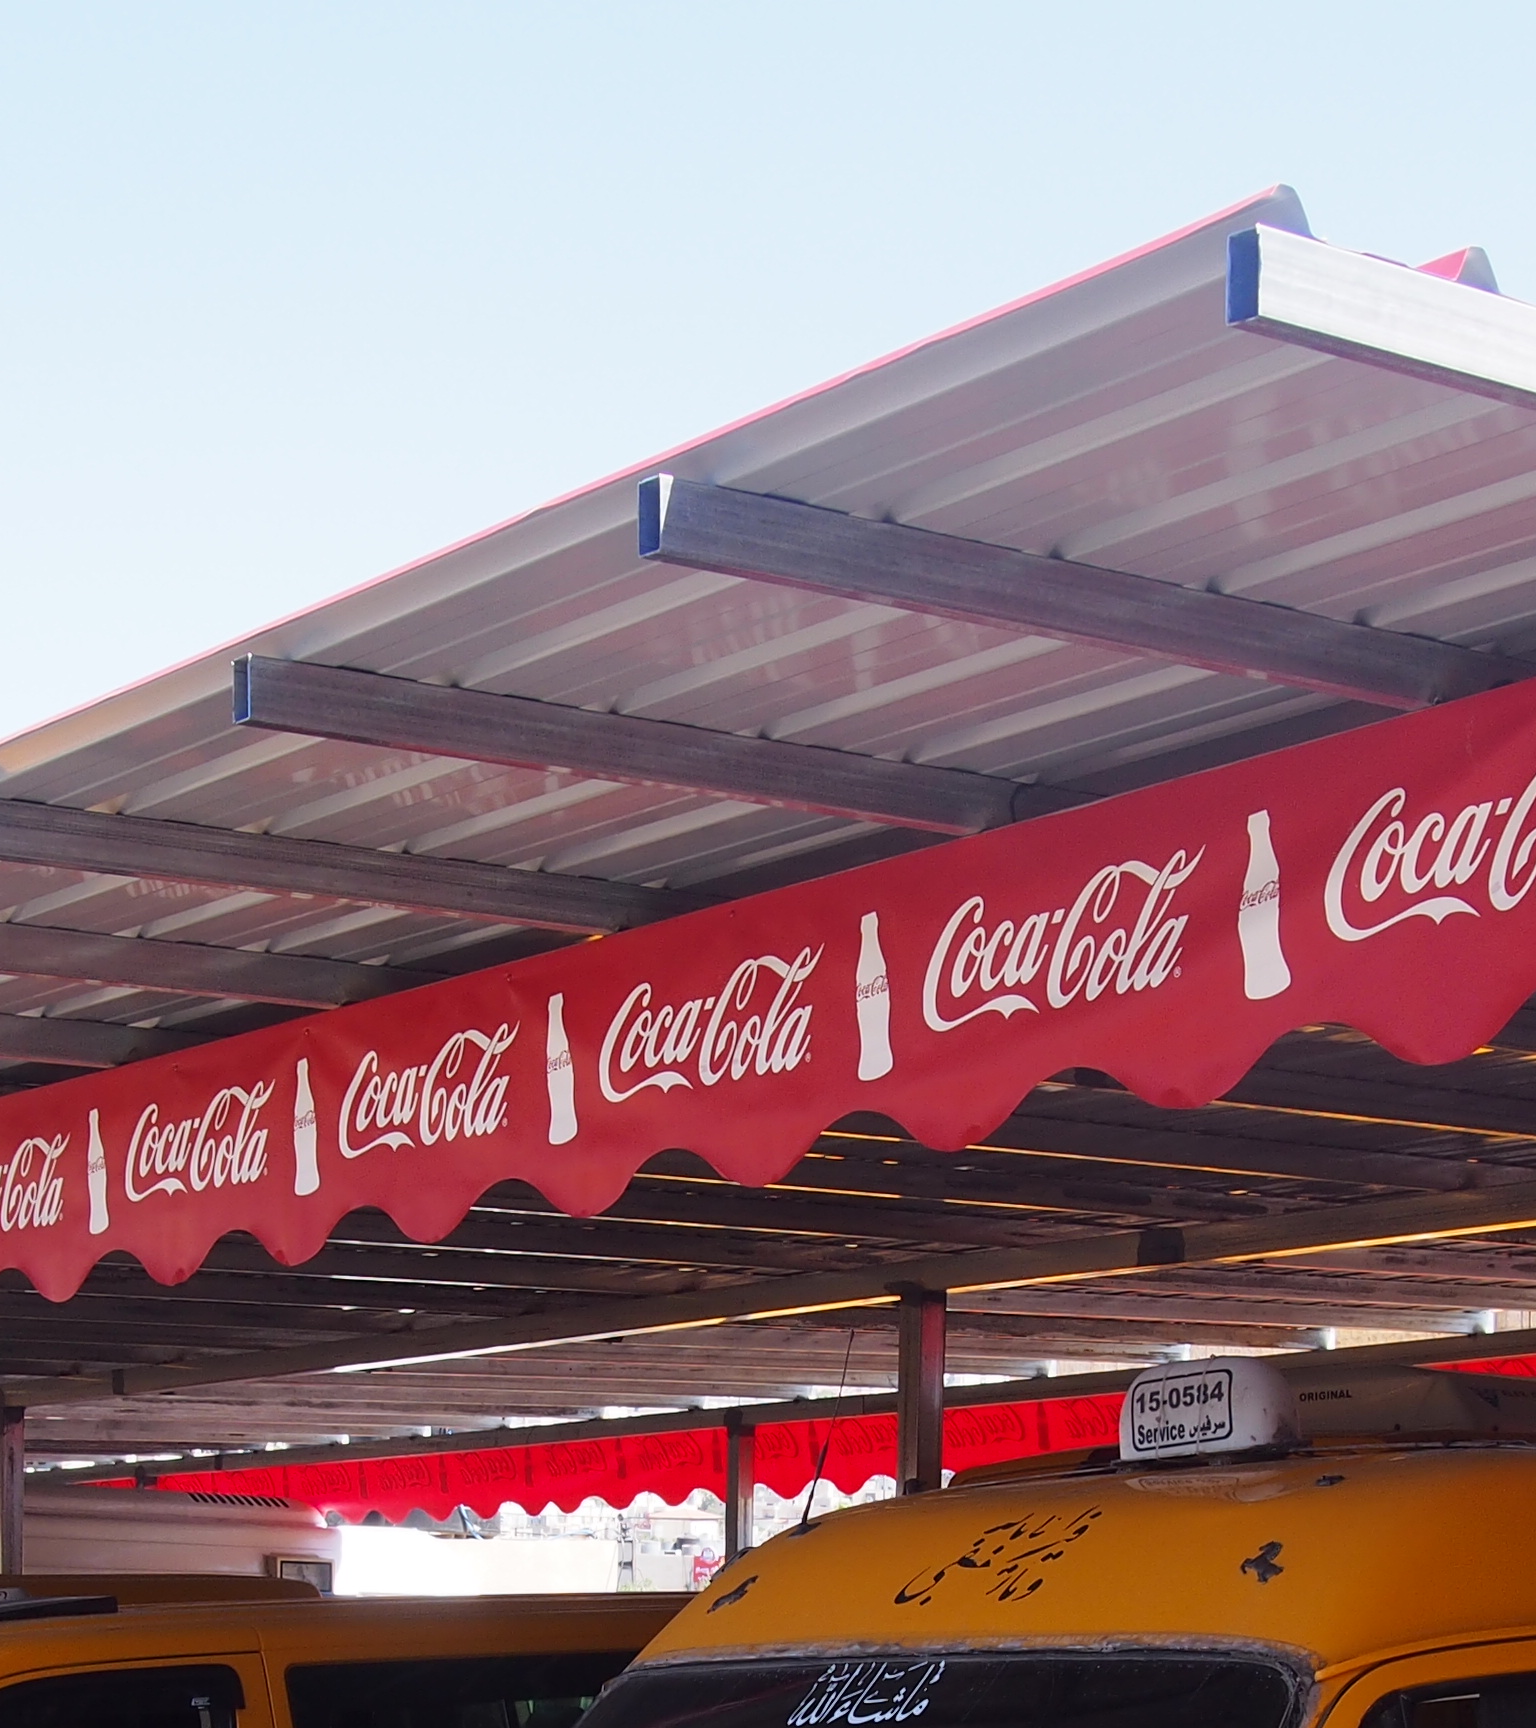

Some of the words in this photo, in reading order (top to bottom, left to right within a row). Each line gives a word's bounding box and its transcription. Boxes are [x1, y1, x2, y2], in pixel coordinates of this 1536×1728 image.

[922, 843, 1206, 1033] Coca-Cola
[598, 943, 824, 1103] Coca-Cola
[124, 1080, 275, 1203] Coca-Cola
[338, 1021, 520, 1159] Coca-Cola
[1136, 1380, 1226, 1414] 15-0584
[1137, 1422, 1186, 1445] Service
[1299, 1388, 1353, 1402] ORIGINAL
